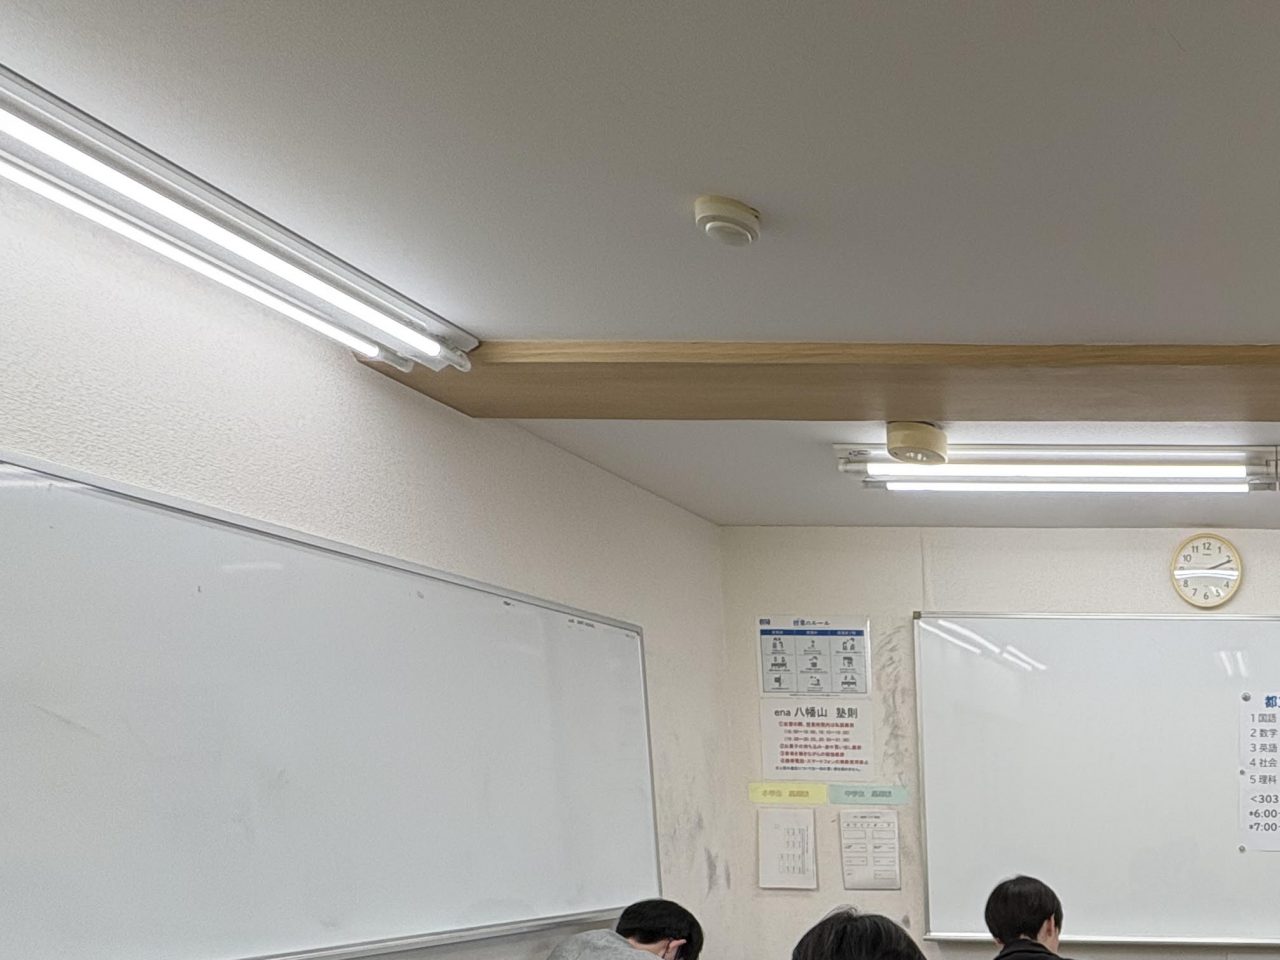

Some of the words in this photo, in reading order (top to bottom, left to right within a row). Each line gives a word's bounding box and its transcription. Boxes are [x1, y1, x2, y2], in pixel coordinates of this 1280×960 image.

[1202, 542, 1212, 550] 12
[1183, 554, 1192, 563] 10
[774, 709, 791, 717] ena
[794, 706, 828, 718] 八幡山
[836, 707, 858, 719] 塾則
[1250, 728, 1257, 738] 2
[1259, 728, 1279, 738] 数学
[1249, 743, 1257, 753] 3
[1259, 743, 1278, 753] 英語
[1249, 758, 1256, 767] 4
[1259, 758, 1278, 768] 社会
[1249, 775, 1256, 784] 5
[1258, 774, 1277, 785] 理科
